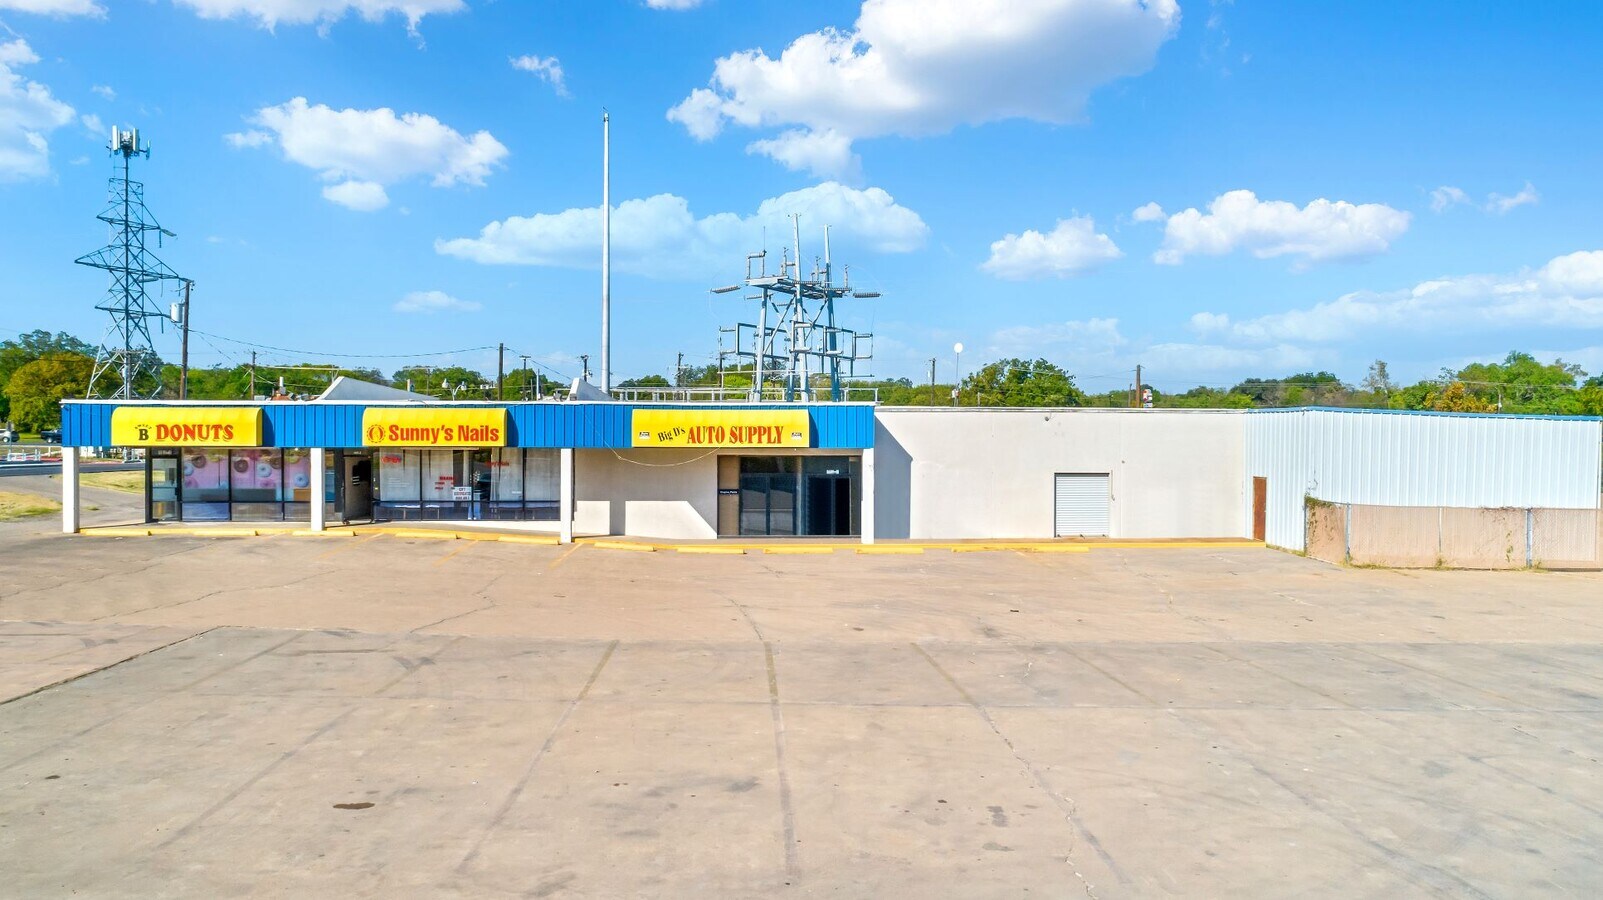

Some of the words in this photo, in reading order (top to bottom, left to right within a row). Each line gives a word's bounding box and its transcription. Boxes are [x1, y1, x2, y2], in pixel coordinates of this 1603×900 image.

[138, 428, 149, 441] B
[155, 423, 234, 442] DONUTS
[388, 424, 454, 444] Sunny's
[458, 425, 499, 442] Nails
[657, 430, 673, 442] Big
[673, 426, 686, 437] D's
[687, 425, 726, 444] AUTO
[729, 425, 784, 444] SUPPLY
